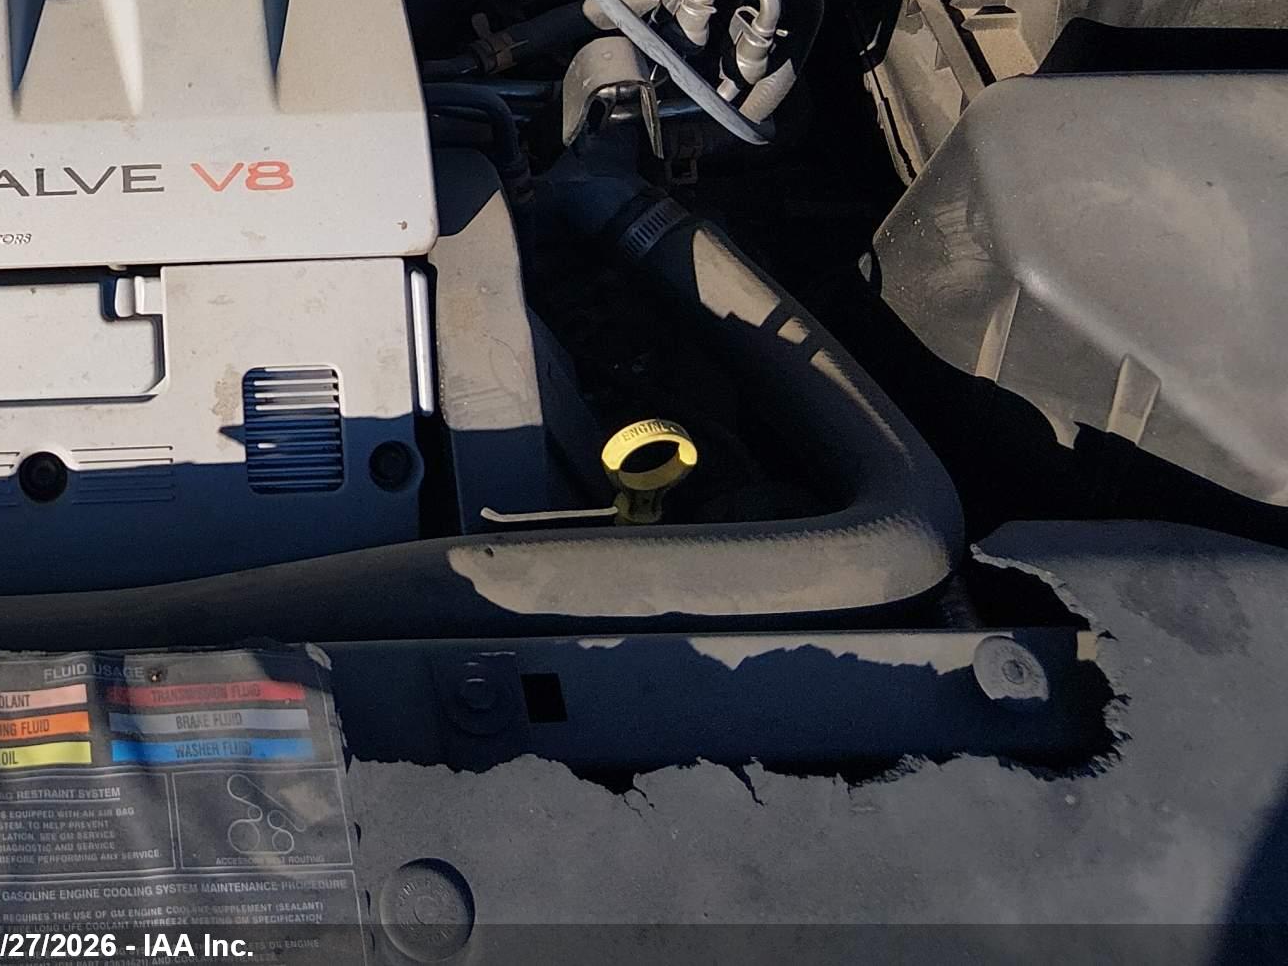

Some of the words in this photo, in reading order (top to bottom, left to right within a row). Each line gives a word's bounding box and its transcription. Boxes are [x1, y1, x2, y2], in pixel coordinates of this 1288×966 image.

[190, 161, 294, 193] V8
[43, 663, 87, 680] FLUID
[92, 665, 145, 679] USAGE
[151, 684, 228, 702] TRANSMISSION
[231, 683, 261, 697] FLUID
[21, 718, 50, 734] FLUID
[175, 714, 210, 729] BRAKE
[213, 712, 243, 727] FLUID
[1, 750, 18, 765] OIL
[175, 742, 219, 758] WASHER
[222, 741, 252, 756] FLUID
[16, 789, 74, 801] RESTRAINT
[78, 787, 120, 799] SYSTEM
[115, 806, 135, 817] BAG
[43, 820, 66, 829] HELP
[0, 854, 35, 864] BEFORE
[37, 853, 98, 863] PERFORMING
[288, 855, 325, 864] ROUTING
[2, 889, 56, 902] GASOLINE
[59, 888, 100, 900] ENGINE
[103, 886, 152, 898] COOLING
[155, 884, 198, 895] SYSTEM
[201, 882, 279, 893] MAINTENANCE
[281, 879, 348, 891] PROCEDURE
[3, 912, 50, 923] REQUIRES
[53, 912, 71, 921] THE
[73, 911, 92, 920] USE
[95, 910, 108, 919] OF
[128, 907, 162, 917] ENGINE
[213, 903, 272, 914] SUPPLEMENT
[34, 923, 60, 933] LONG
[63, 922, 83, 932] LIFE
[86, 921, 130, 931] COOLANT
